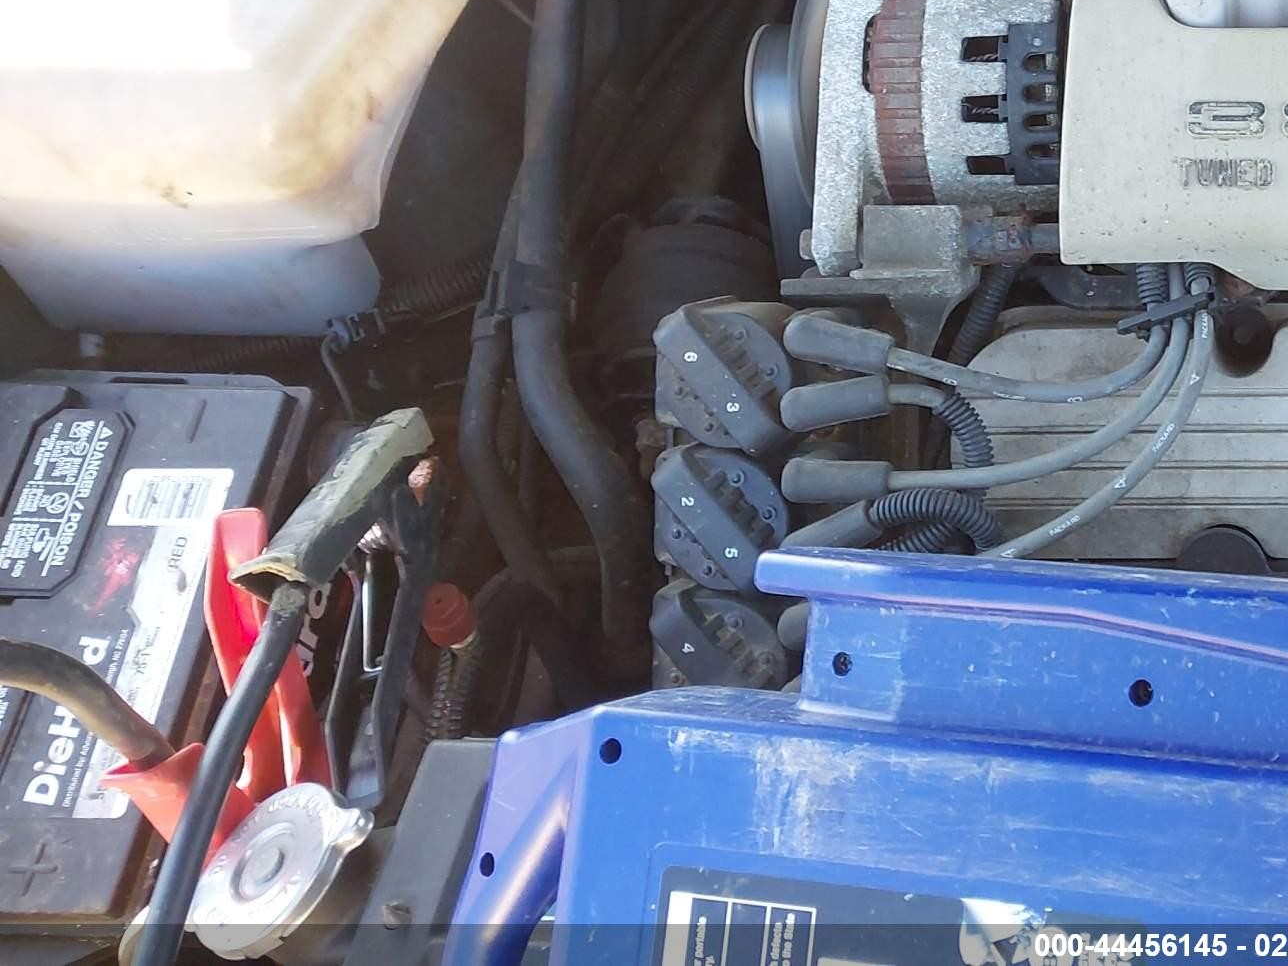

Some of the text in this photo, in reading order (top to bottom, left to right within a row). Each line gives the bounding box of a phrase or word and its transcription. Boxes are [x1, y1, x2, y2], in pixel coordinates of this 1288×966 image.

[1174, 157, 1274, 188] TUNED
[684, 350, 699, 364] 6
[726, 402, 740, 413] 3
[76, 440, 109, 498] DANGER
[680, 496, 695, 507] 2
[50, 512, 83, 567] POISON
[724, 547, 739, 559] 5
[681, 642, 696, 655] 4
[23, 635, 111, 806] DieHd
